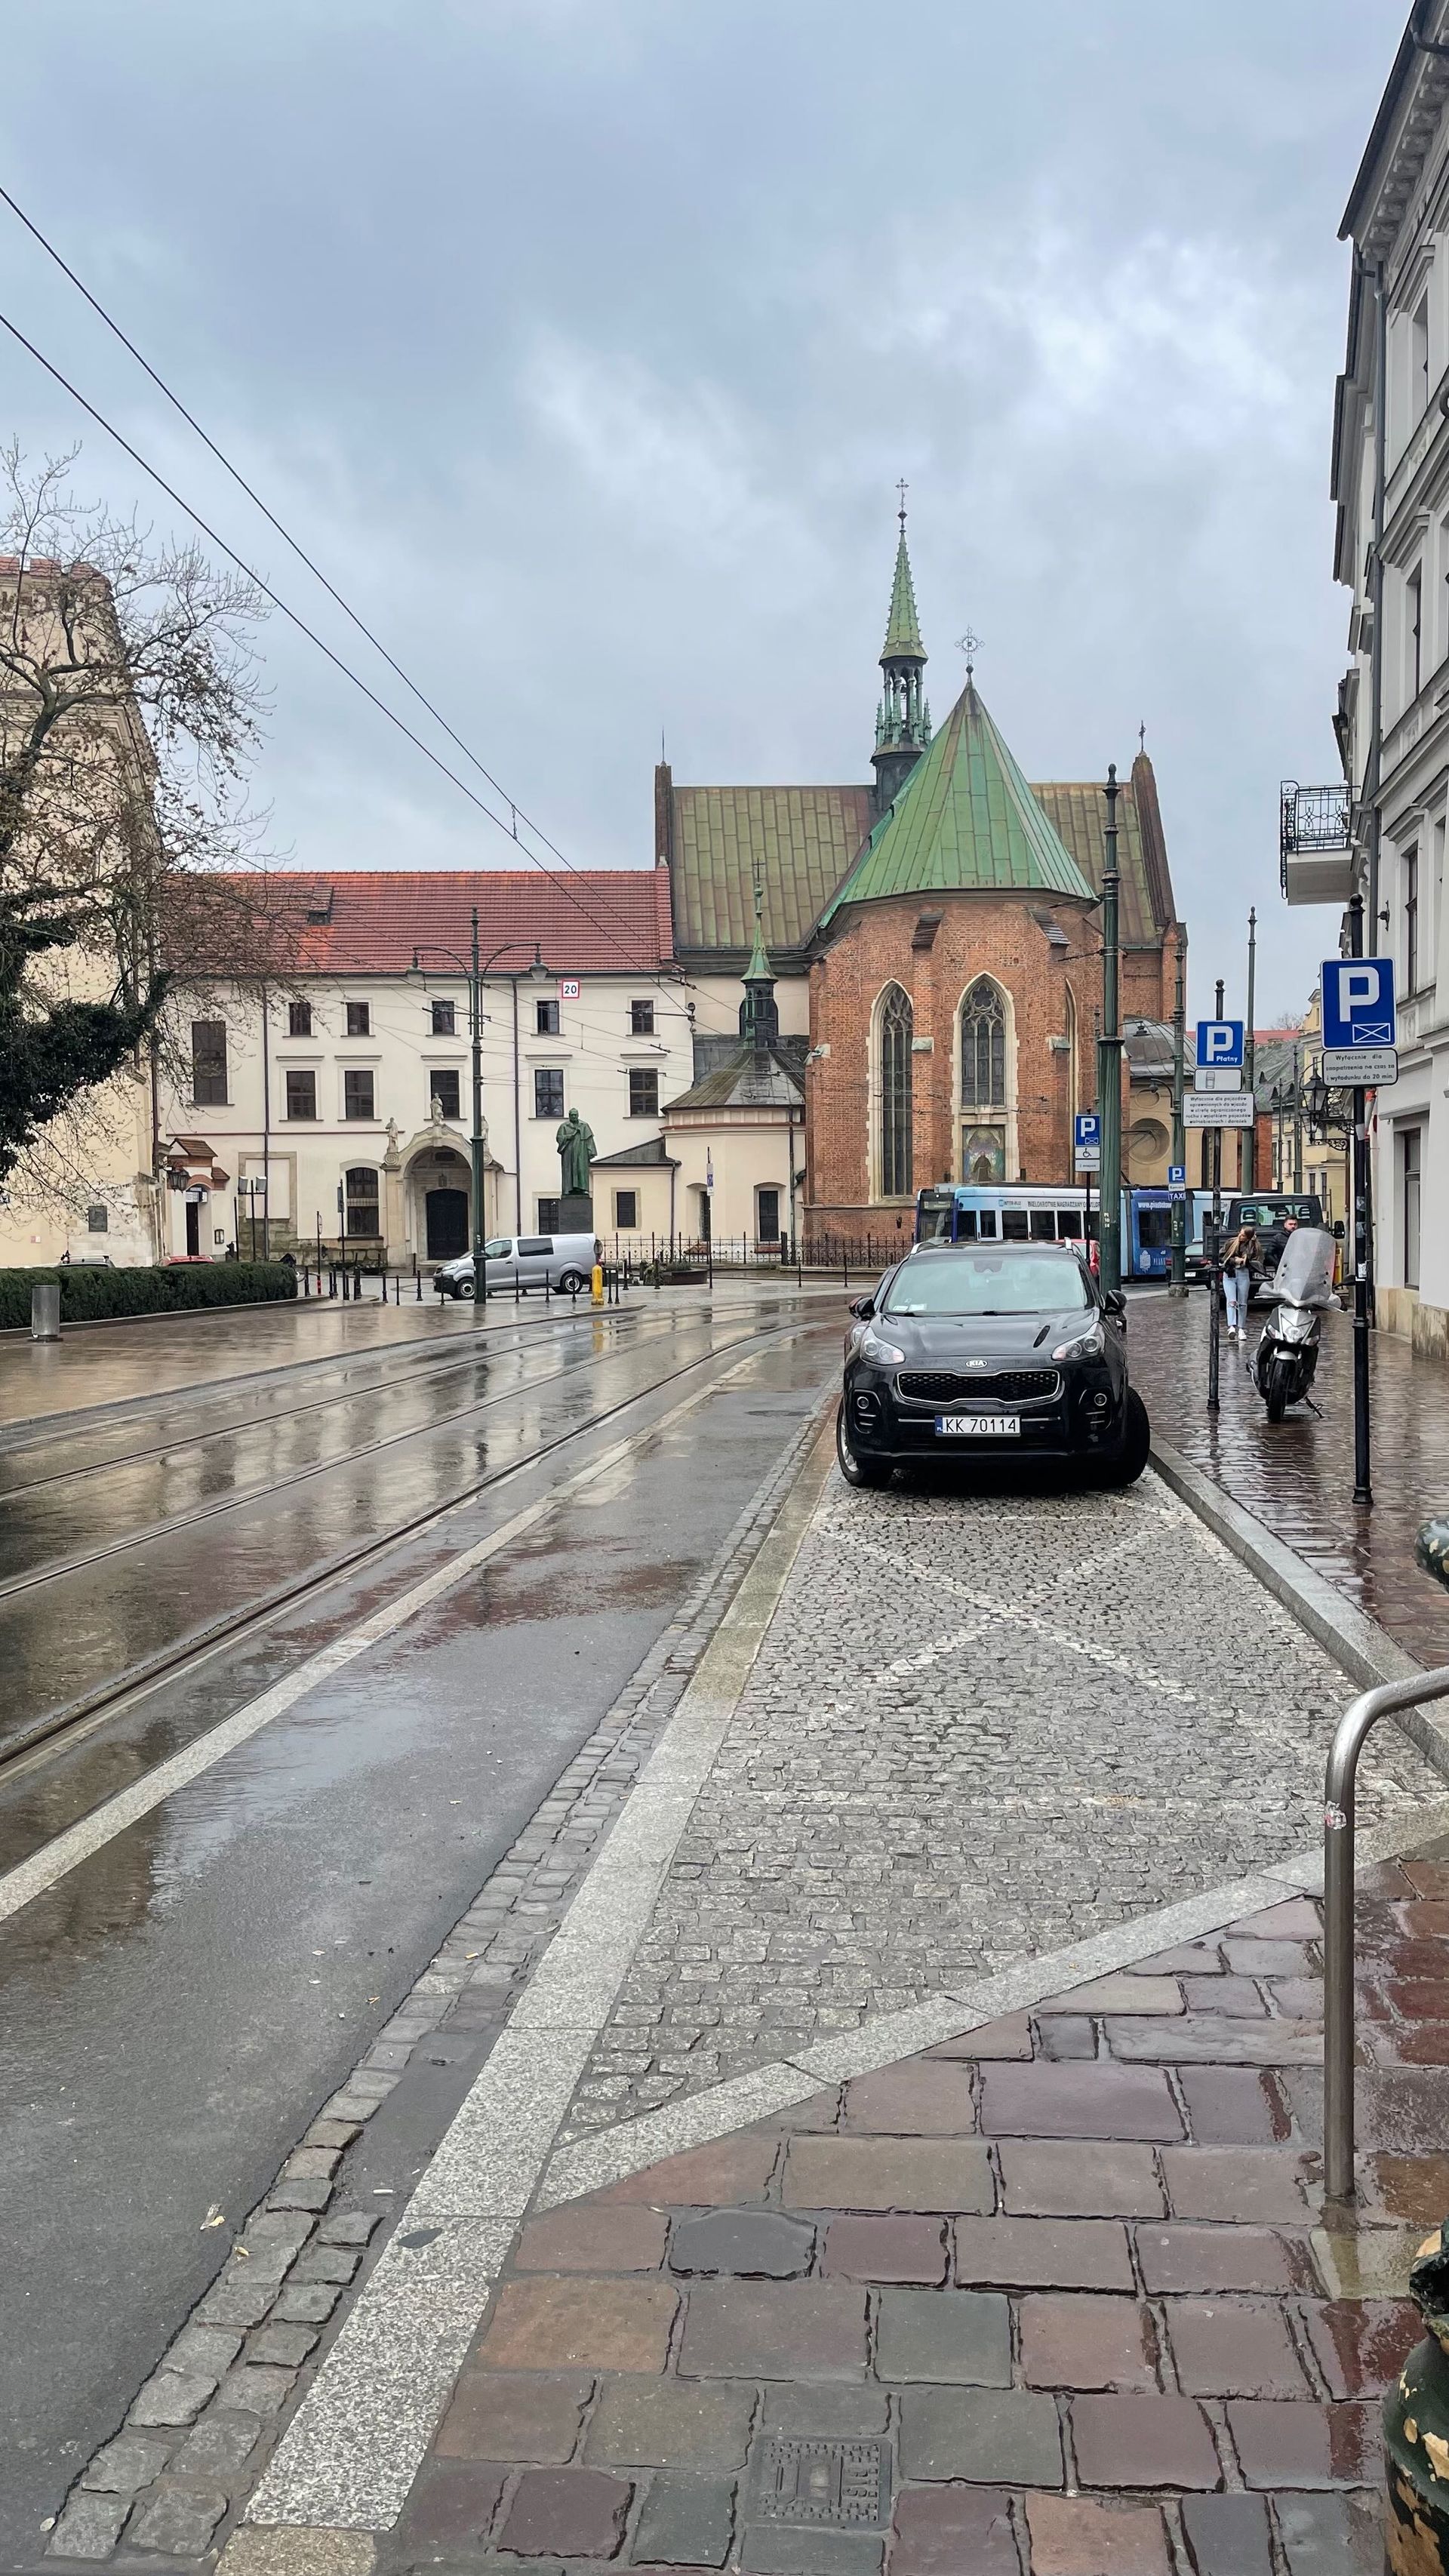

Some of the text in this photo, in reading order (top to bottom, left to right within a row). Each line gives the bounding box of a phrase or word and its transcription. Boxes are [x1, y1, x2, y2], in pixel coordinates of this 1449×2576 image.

[565, 985, 577, 994] 20
[1339, 967, 1380, 1022] P
[1207, 1026, 1233, 1061] P
[1081, 1118, 1096, 1137] P
[1172, 1168, 1182, 1181] P
[946, 1419, 1016, 1432] KK 70114
